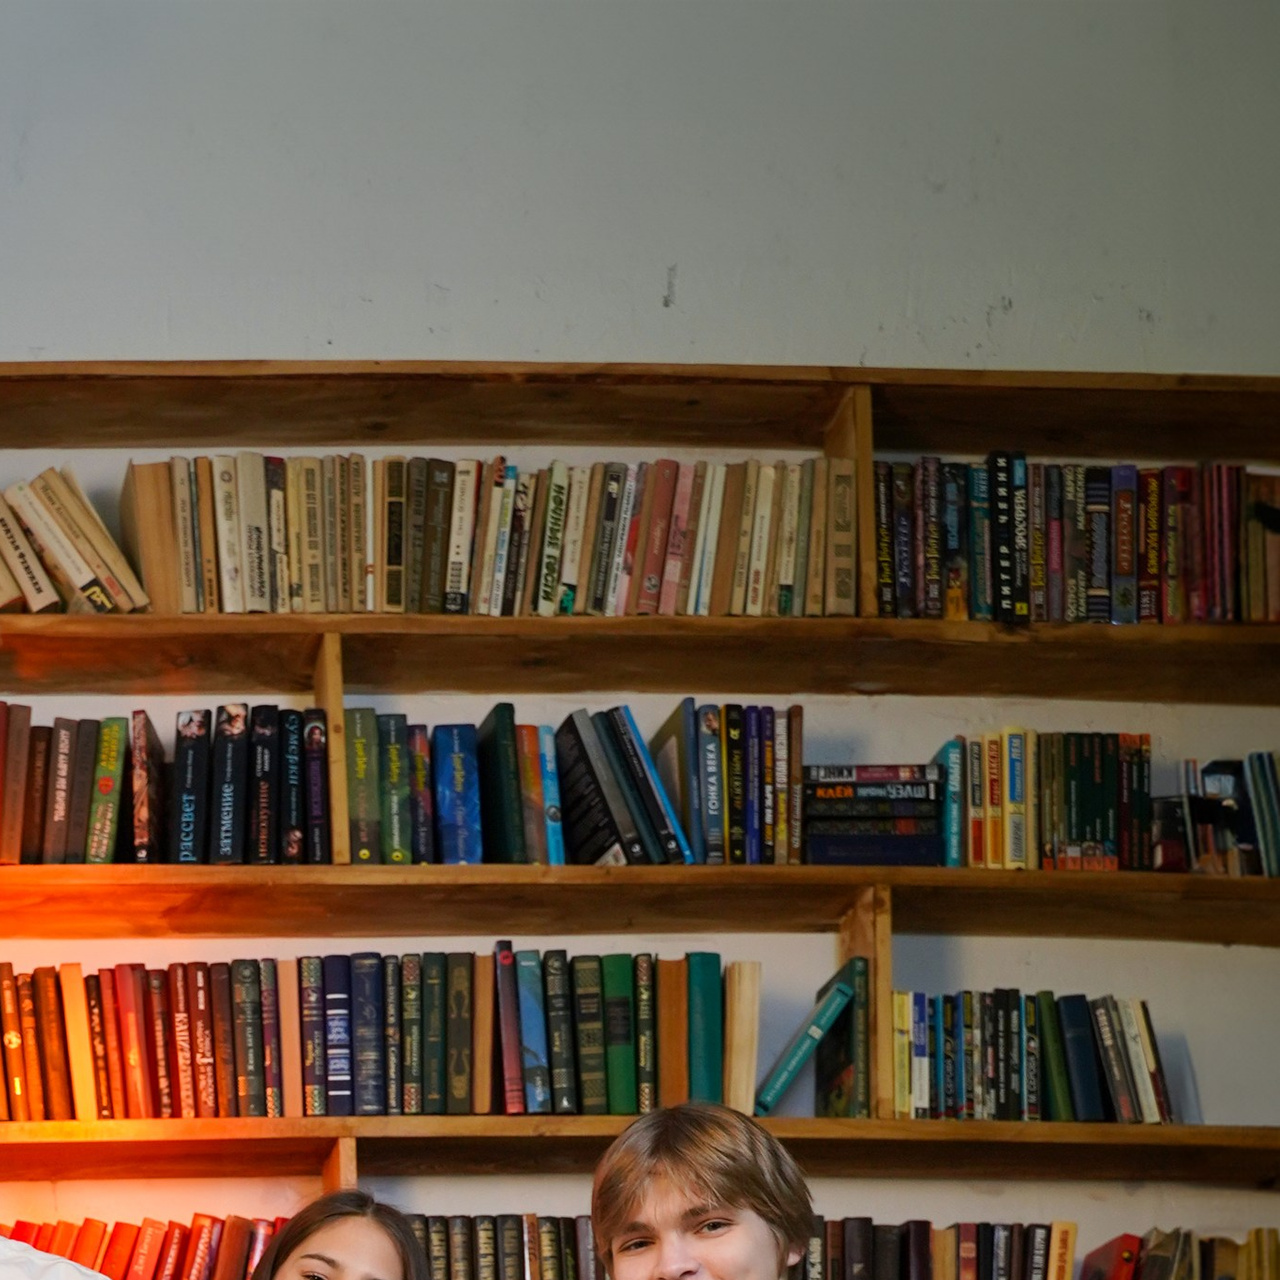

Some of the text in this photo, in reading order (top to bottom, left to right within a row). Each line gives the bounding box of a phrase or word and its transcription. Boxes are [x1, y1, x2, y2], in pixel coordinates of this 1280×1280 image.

[542, 484, 566, 603] НОЧНЫЕ ГОСТИ
[996, 458, 1012, 610] ПИТЕР ЧЕЙНИ
[1014, 489, 1027, 551] ЭРОСФЕРА
[286, 715, 300, 785] сумерки
[705, 742, 719, 815] ГОНКА ВЕКА
[179, 792, 197, 862] рассвет
[219, 783, 234, 856] затмение
[814, 784, 854, 799] КЛЕЙ
